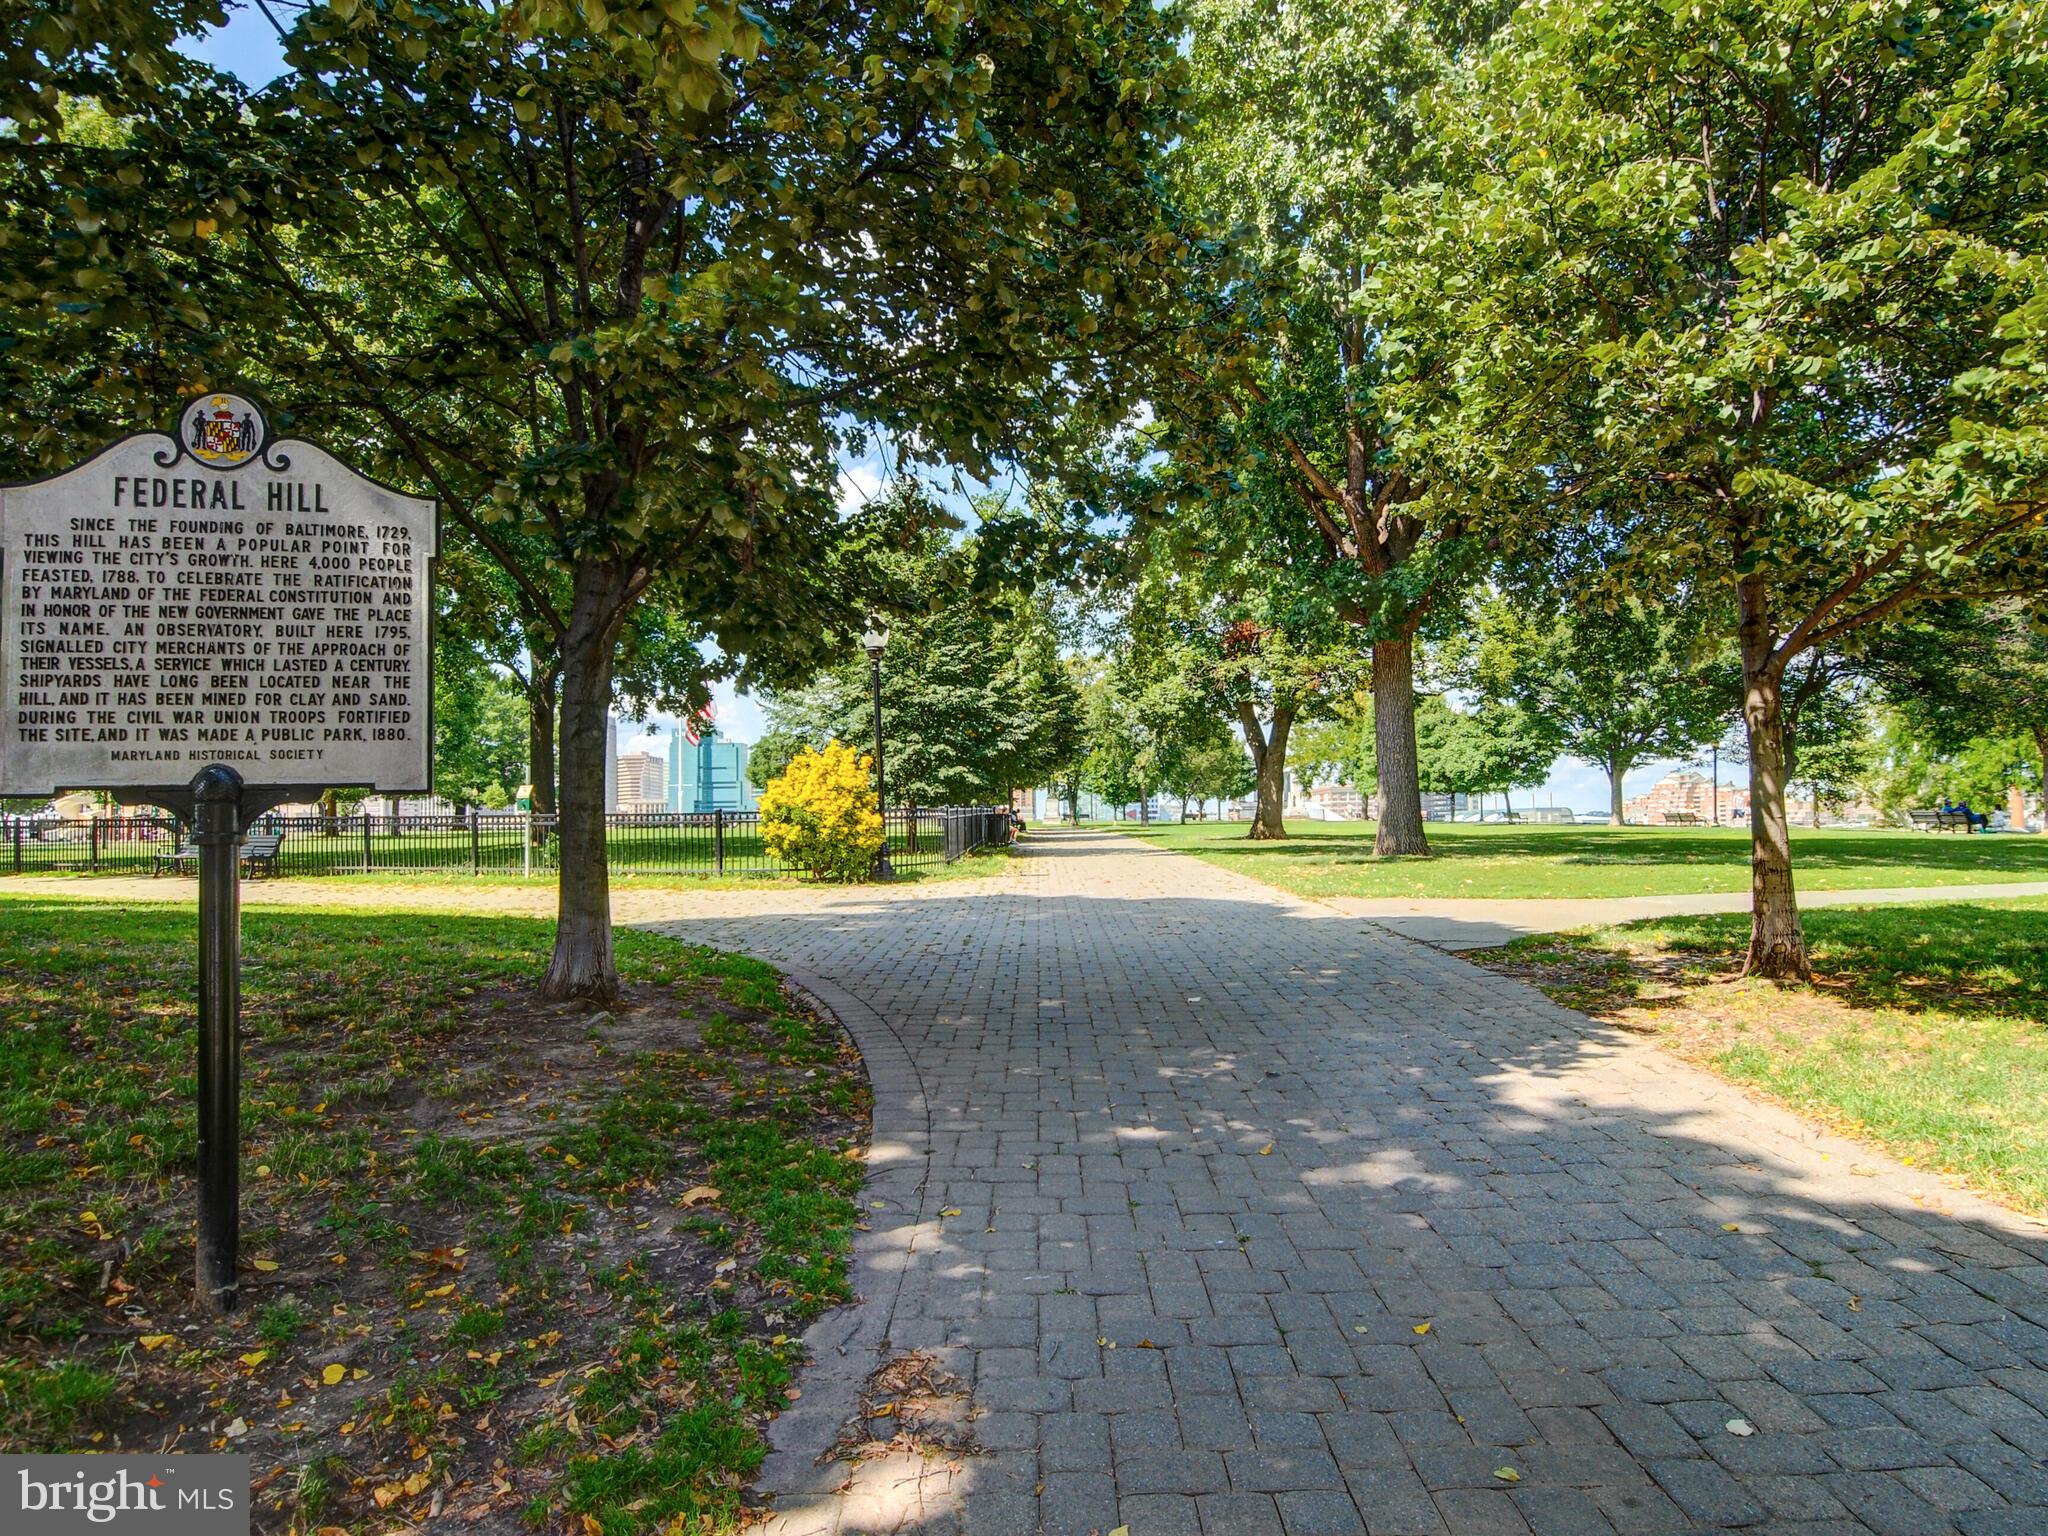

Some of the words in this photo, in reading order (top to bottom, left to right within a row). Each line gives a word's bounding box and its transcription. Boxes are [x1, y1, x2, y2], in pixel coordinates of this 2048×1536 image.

[114, 477, 245, 510] FEDERAL
[268, 482, 329, 512] HILL
[70, 518, 115, 531] SINCE
[128, 519, 157, 532] THE
[170, 520, 244, 534] FOUNDING
[256, 522, 274, 535] OF
[24, 534, 59, 547] THIS
[73, 534, 106, 547] HILL
[120, 536, 150, 548] HAS
[162, 537, 204, 550] BEEN
[216, 538, 226, 551] A
[238, 538, 310, 552] POPULAR
[322, 541, 369, 554] POINT
[383, 542, 410, 557] FOR
[24, 550, 83, 564] VIEWING
[92, 552, 120, 564] THE
[130, 552, 178, 566] CITY'S
[188, 554, 253, 567] GROWTH.
[261, 556, 298, 568] HERE
[360, 558, 412, 573] PEOPLE
[147, 571, 165, 584] TO
[177, 572, 262, 585] CELEBRATE
[273, 574, 300, 586] THE
[314, 575, 412, 590] RATIFICATION
[22, 586, 41, 599] BY
[52, 586, 130, 600] MARYLAND
[138, 588, 155, 600] OF
[162, 588, 190, 600] THE
[200, 589, 264, 602] FEDERAL
[270, 590, 372, 604] CONSTITUTION
[383, 592, 412, 605] AND
[22, 604, 35, 617] IN
[44, 604, 90, 617] HONOR
[99, 605, 116, 617] OF
[122, 605, 150, 618] THE
[159, 606, 188, 618] NEW
[196, 606, 284, 620] GOVERNMENT
[292, 608, 325, 620] GAVE
[334, 608, 360, 621] THE
[368, 609, 412, 622] PLACE
[21, 622, 45, 635] ITS
[60, 622, 109, 635] NAME.
[124, 623, 144, 636] AN
[276, 625, 315, 637] BUILT
[327, 626, 363, 638] HERE
[20, 640, 103, 653] SIGNALLED
[113, 641, 147, 654] CITY
[156, 642, 244, 654] MERCHANTS
[254, 642, 271, 655] OF
[278, 642, 304, 655] THE
[312, 643, 385, 656] APPROACH
[394, 644, 410, 656] OF
[20, 657, 59, 670] THEIR
[155, 658, 211, 670] SERVICE
[221, 658, 264, 671] WHICH
[274, 659, 327, 671] LASTED
[334, 660, 343, 672] A
[20, 674, 101, 687] SHIPYARDS
[114, 674, 150, 687] HAVE
[161, 675, 198, 688] LONG
[211, 675, 248, 688] BEEN
[260, 676, 320, 688] LOCATED
[332, 676, 370, 688] NEAR
[384, 676, 410, 688] THE
[59, 692, 88, 705] AND
[96, 692, 110, 705] IT
[118, 692, 146, 705] HAS
[156, 693, 194, 705] BEEN
[202, 693, 246, 705] MINED
[256, 693, 282, 706] FOR
[290, 693, 325, 706] CLAY
[332, 694, 360, 706] AND
[370, 694, 410, 706] SAND.
[18, 711, 76, 724] DURING
[87, 711, 116, 724] THE
[127, 711, 164, 724] CIVIL
[173, 711, 204, 724] WAR
[214, 711, 259, 724] UNION
[270, 711, 325, 723] TROOPS
[339, 711, 410, 723] FORTIFIED
[18, 728, 48, 742] THE
[136, 728, 150, 741] IT
[159, 728, 188, 741] WAS
[198, 729, 238, 741] MADE
[245, 728, 254, 741] A
[262, 728, 314, 741] PUBLIC
[373, 728, 411, 740] 1880.
[111, 750, 180, 760] MARYLAND
[189, 750, 260, 760] HISTORICAL
[270, 750, 323, 760] SOCIETY
